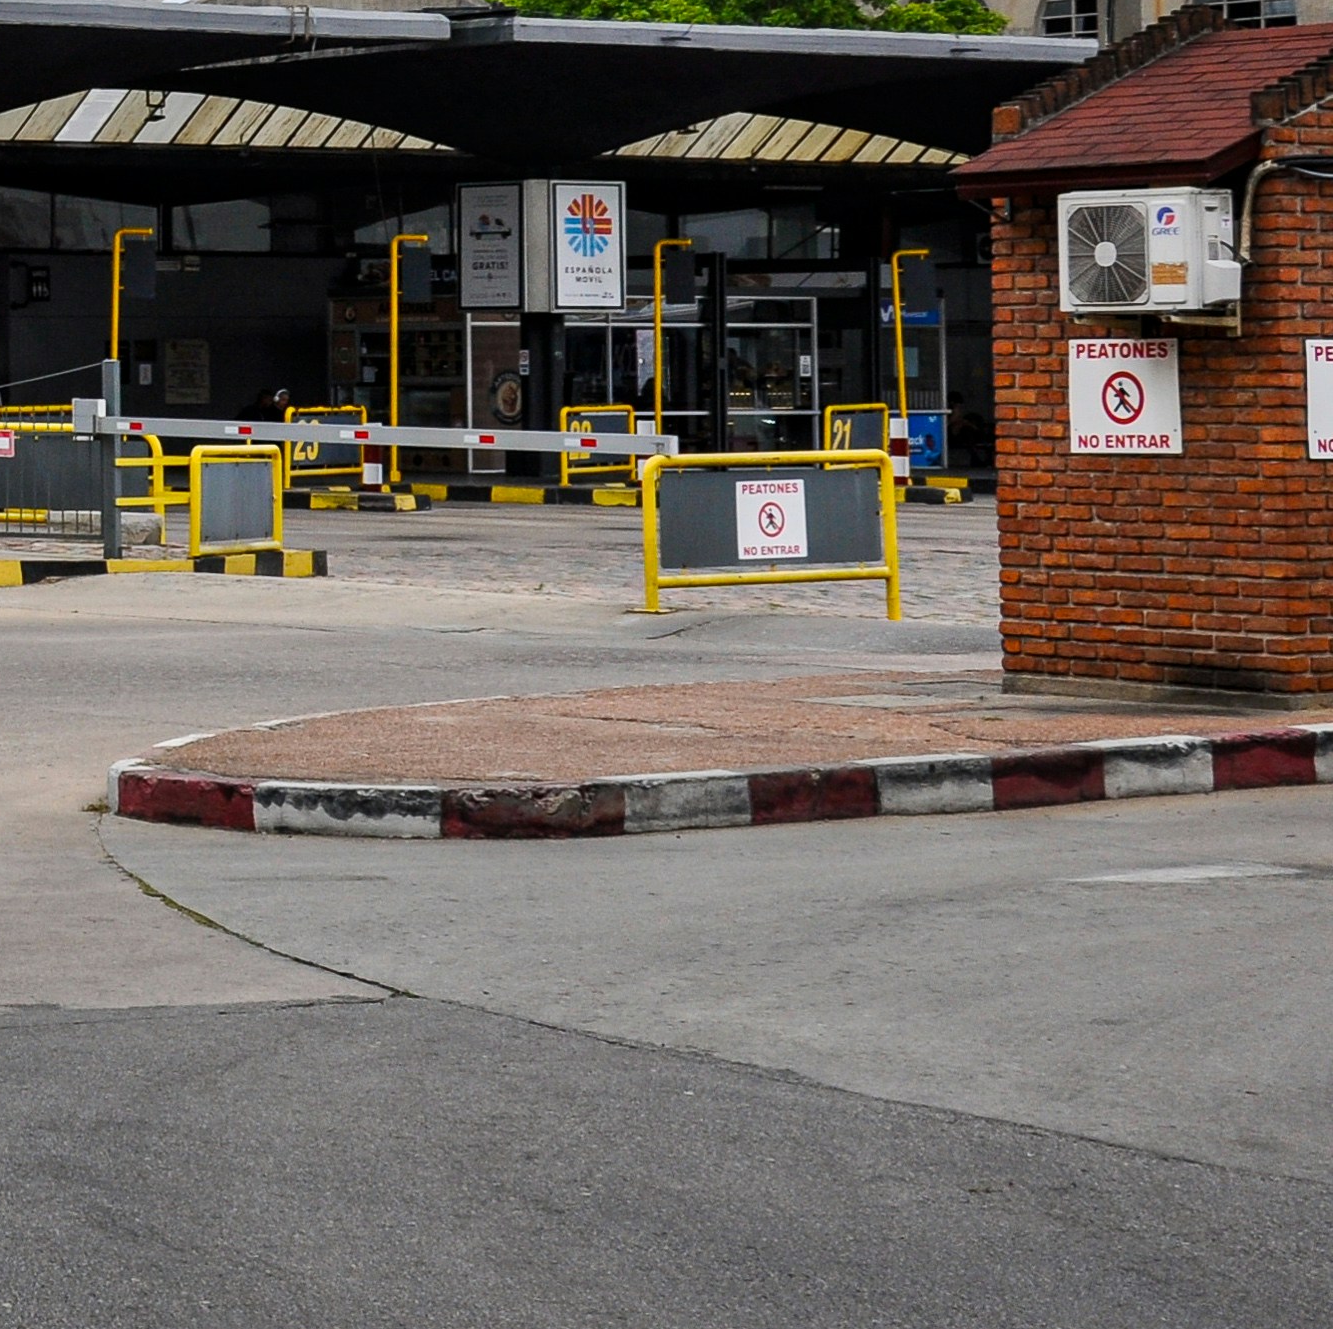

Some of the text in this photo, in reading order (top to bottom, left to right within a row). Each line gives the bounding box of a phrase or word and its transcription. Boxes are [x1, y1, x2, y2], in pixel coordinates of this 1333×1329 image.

[1151, 226, 1181, 236] GREE
[564, 265, 613, 274] ESPAÑOLA
[575, 276, 603, 284] MOVIL
[1076, 342, 1169, 359] PEATONES
[833, 418, 851, 450] 21
[1078, 434, 1171, 449] NO ENTRAR
[742, 483, 799, 494] PEATONES
[743, 545, 800, 556] NO ENTRAR
